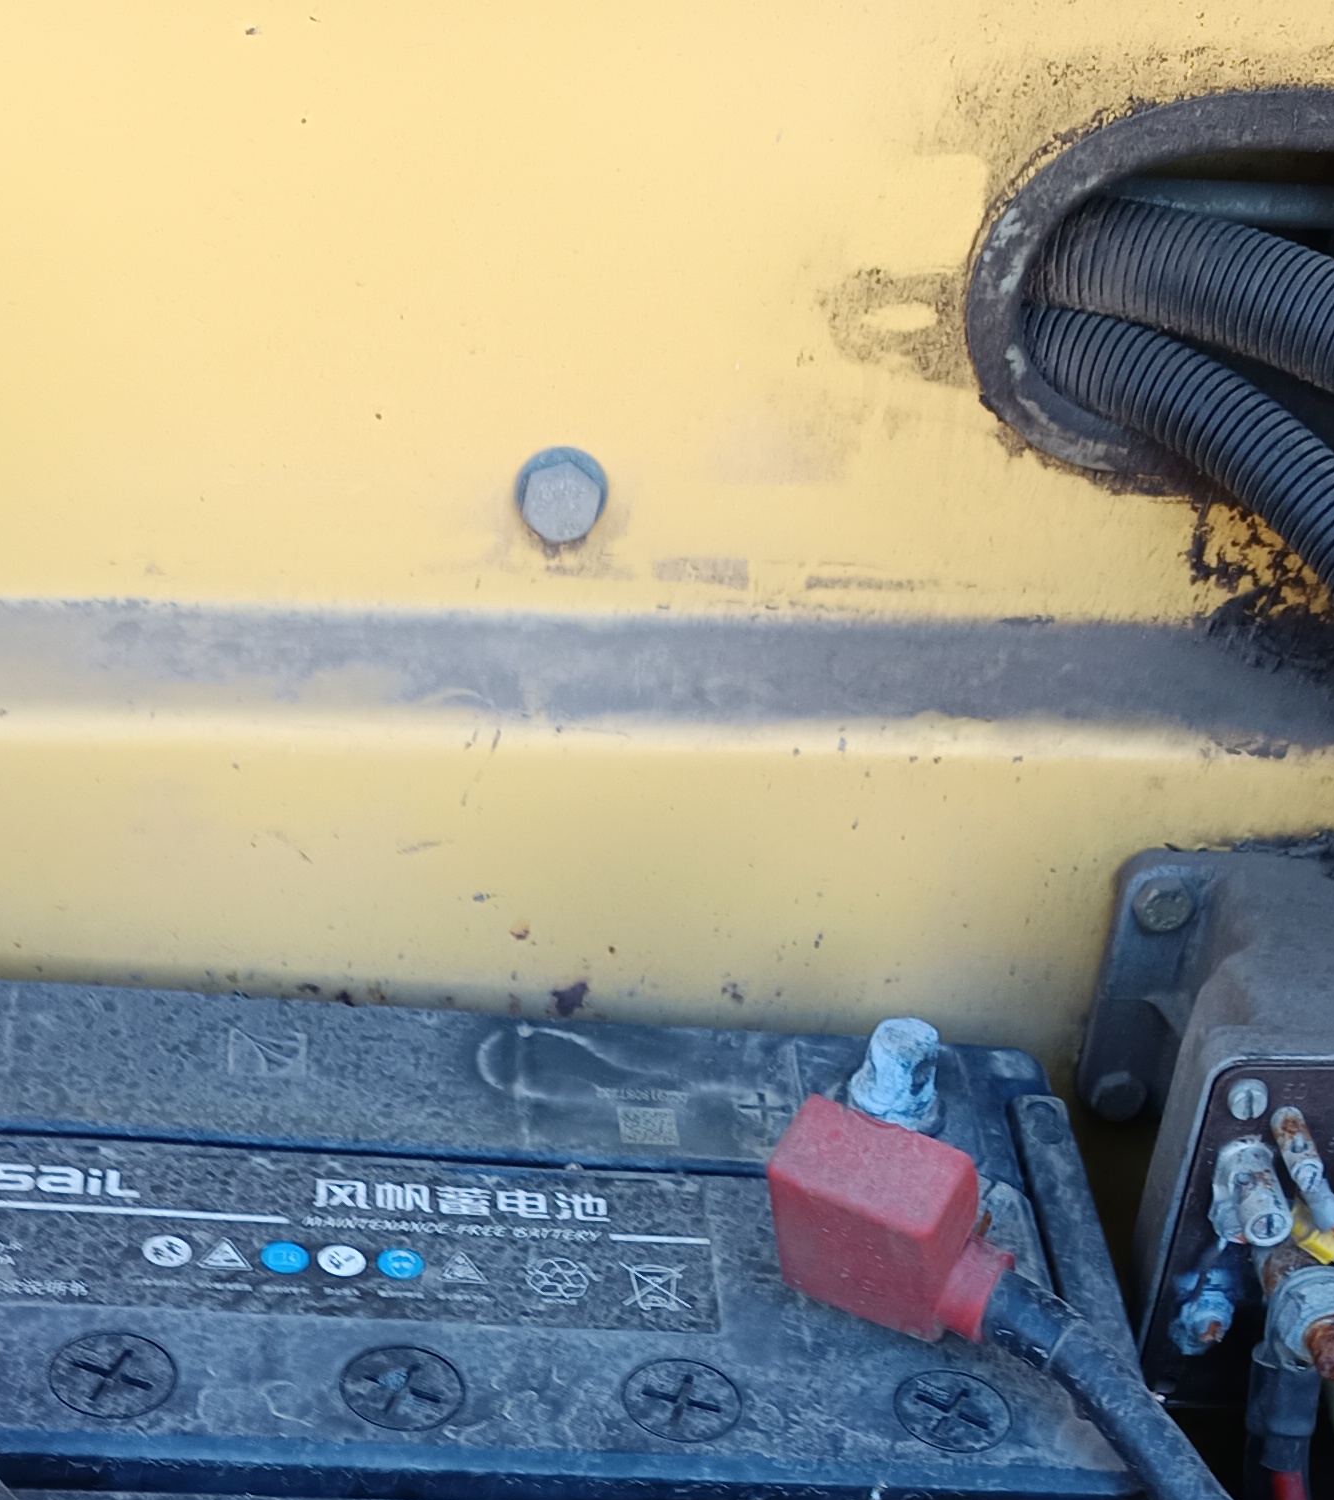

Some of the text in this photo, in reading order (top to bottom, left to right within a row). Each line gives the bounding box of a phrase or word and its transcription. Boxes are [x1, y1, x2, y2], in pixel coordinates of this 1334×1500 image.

[313, 1178, 612, 1222] 风帆蓄电池
